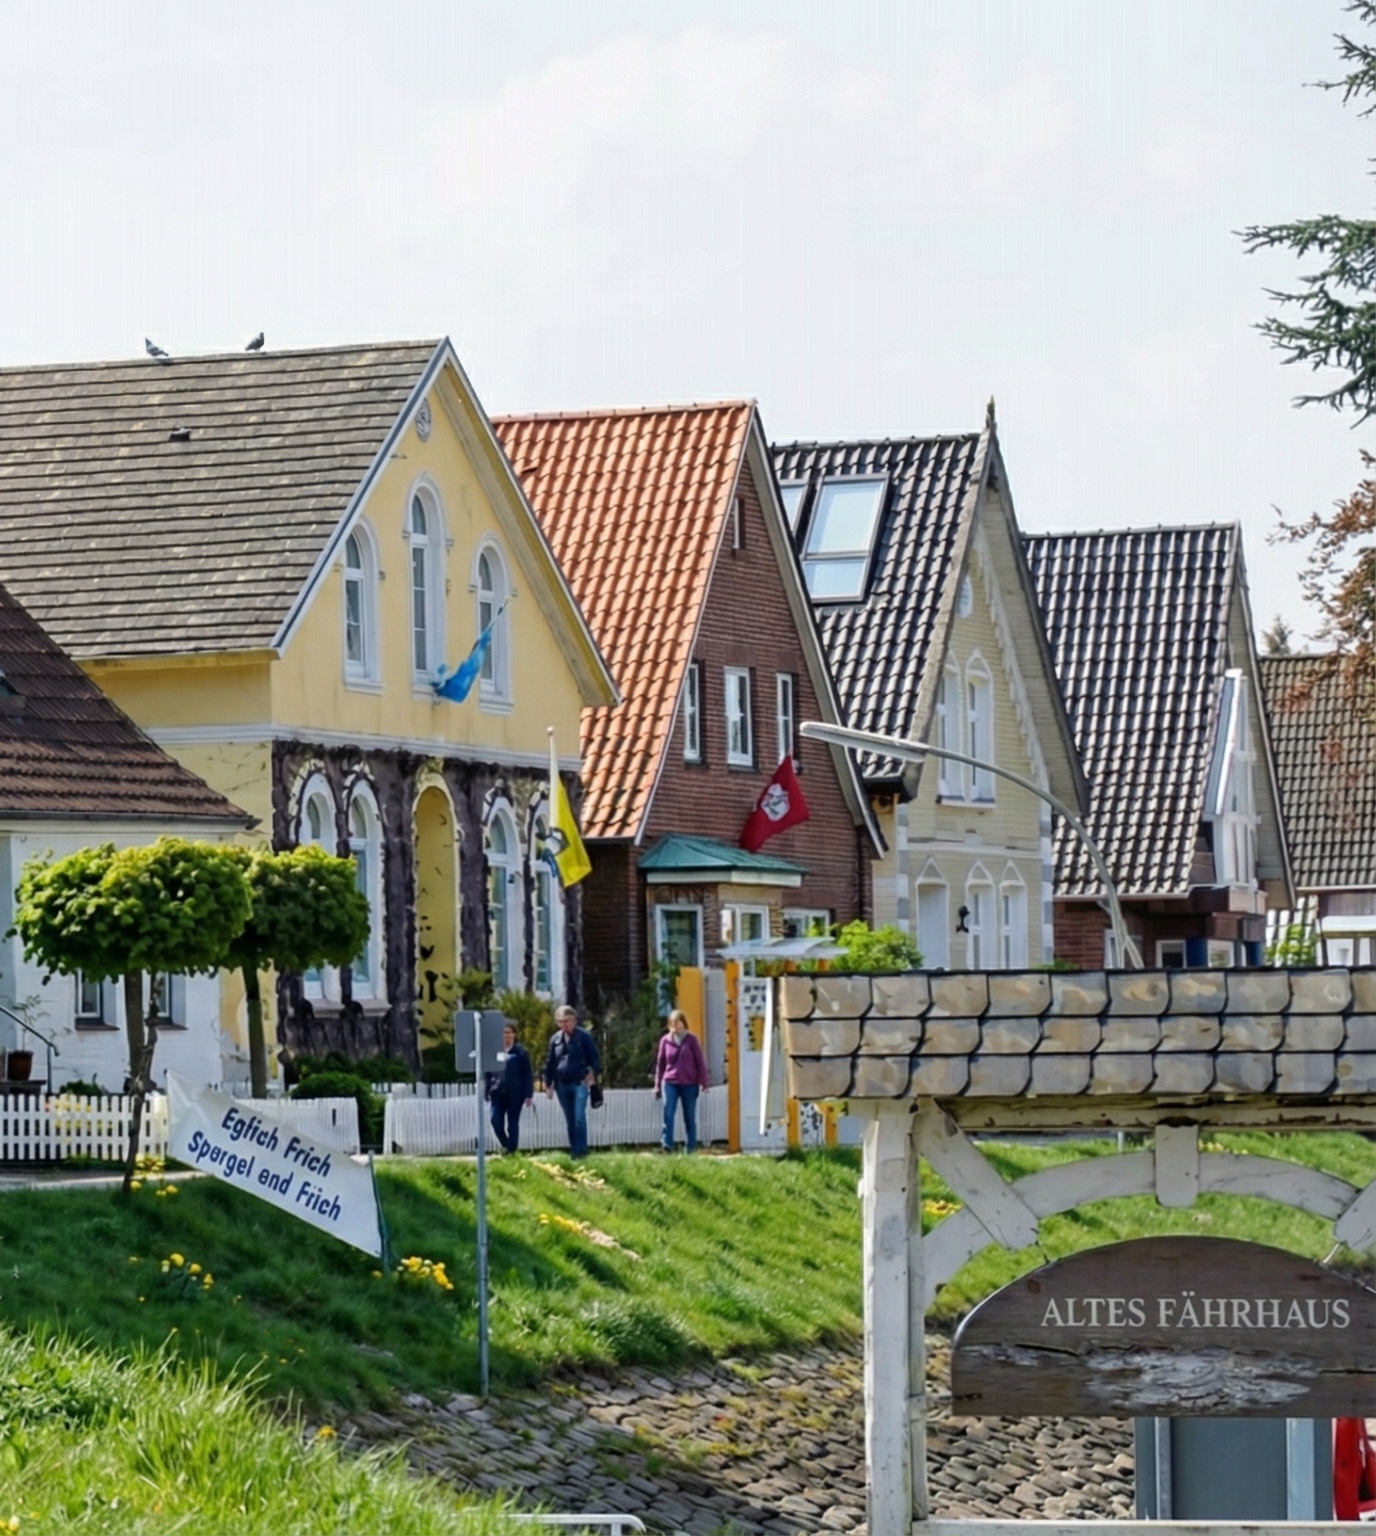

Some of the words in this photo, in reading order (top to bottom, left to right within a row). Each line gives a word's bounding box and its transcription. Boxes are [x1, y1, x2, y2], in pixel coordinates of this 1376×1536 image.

[283, 1136, 331, 1178] Frich
[1040, 1297, 1146, 1328] ALTES
[1156, 1290, 1351, 1329] FÄHRHAUS
